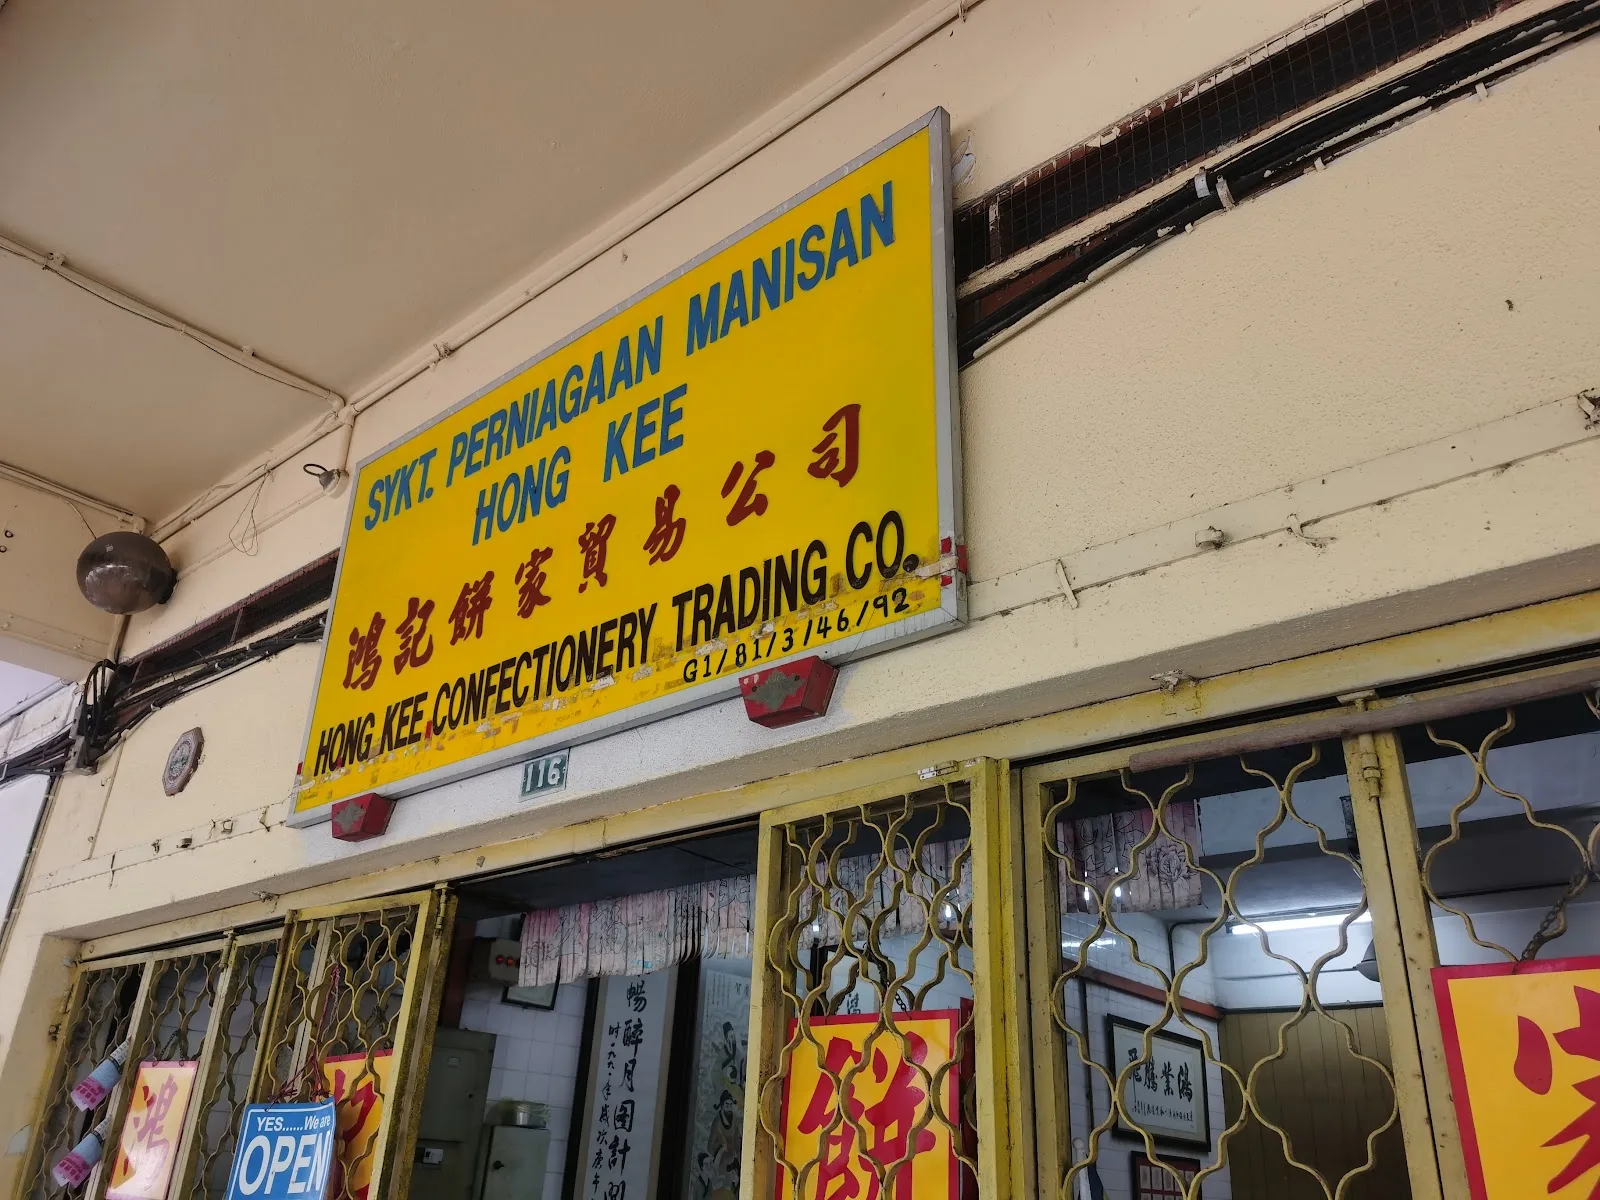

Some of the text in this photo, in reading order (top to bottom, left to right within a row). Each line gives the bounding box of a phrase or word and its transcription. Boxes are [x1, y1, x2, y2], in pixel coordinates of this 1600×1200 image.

[364, 181, 894, 531] SYKT. PERNIAGAAN MANISAN
[472, 384, 688, 546] HONG KEE
[342, 403, 862, 692] 鴻記餅家貿易公司
[313, 510, 920, 777] HONG KEE CONFECTIONERY TRADING CO.
[682, 587, 911, 684] G1/81/3/46/92
[525, 757, 562, 792] 116
[239, 1130, 330, 1195] OPEN
